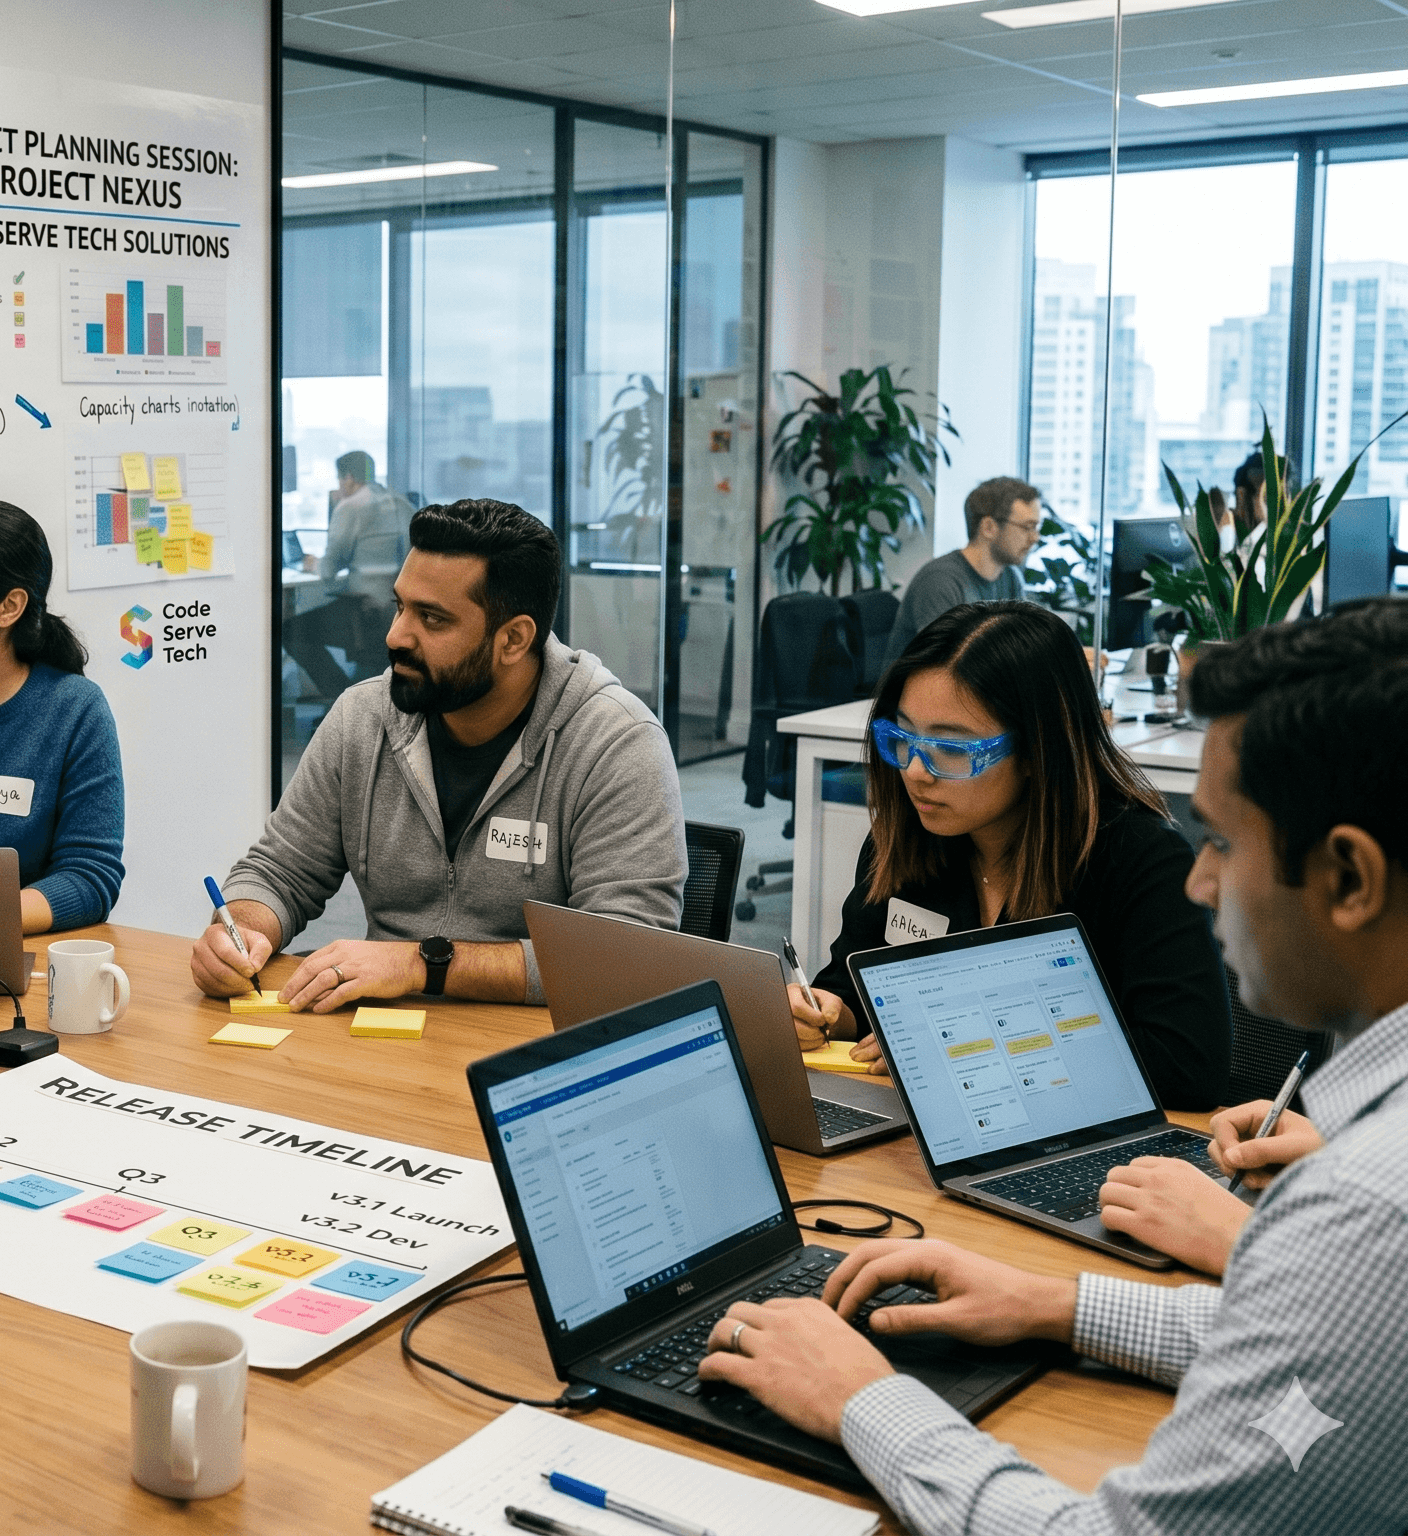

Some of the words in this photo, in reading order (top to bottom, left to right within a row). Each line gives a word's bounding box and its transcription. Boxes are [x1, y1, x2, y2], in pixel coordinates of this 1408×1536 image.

[25, 129, 140, 166] PLANNING
[146, 143, 239, 177] SESSION:
[103, 174, 181, 209] NEXUS
[64, 225, 117, 251] TECH
[123, 230, 230, 259] SOLUTIONS
[79, 396, 135, 425] Capacity
[141, 394, 181, 414] charts
[162, 601, 212, 620] Code
[162, 623, 217, 643] Serve
[163, 643, 208, 664] Tech
[39, 1075, 237, 1134] RELEASE
[239, 1124, 463, 1186] TIMELINE
[117, 1168, 167, 1184] Q3
[329, 1190, 387, 1212] v3.1
[390, 1204, 500, 1238] Launch
[299, 1213, 361, 1235] v3.2
[365, 1227, 429, 1251] Dev
